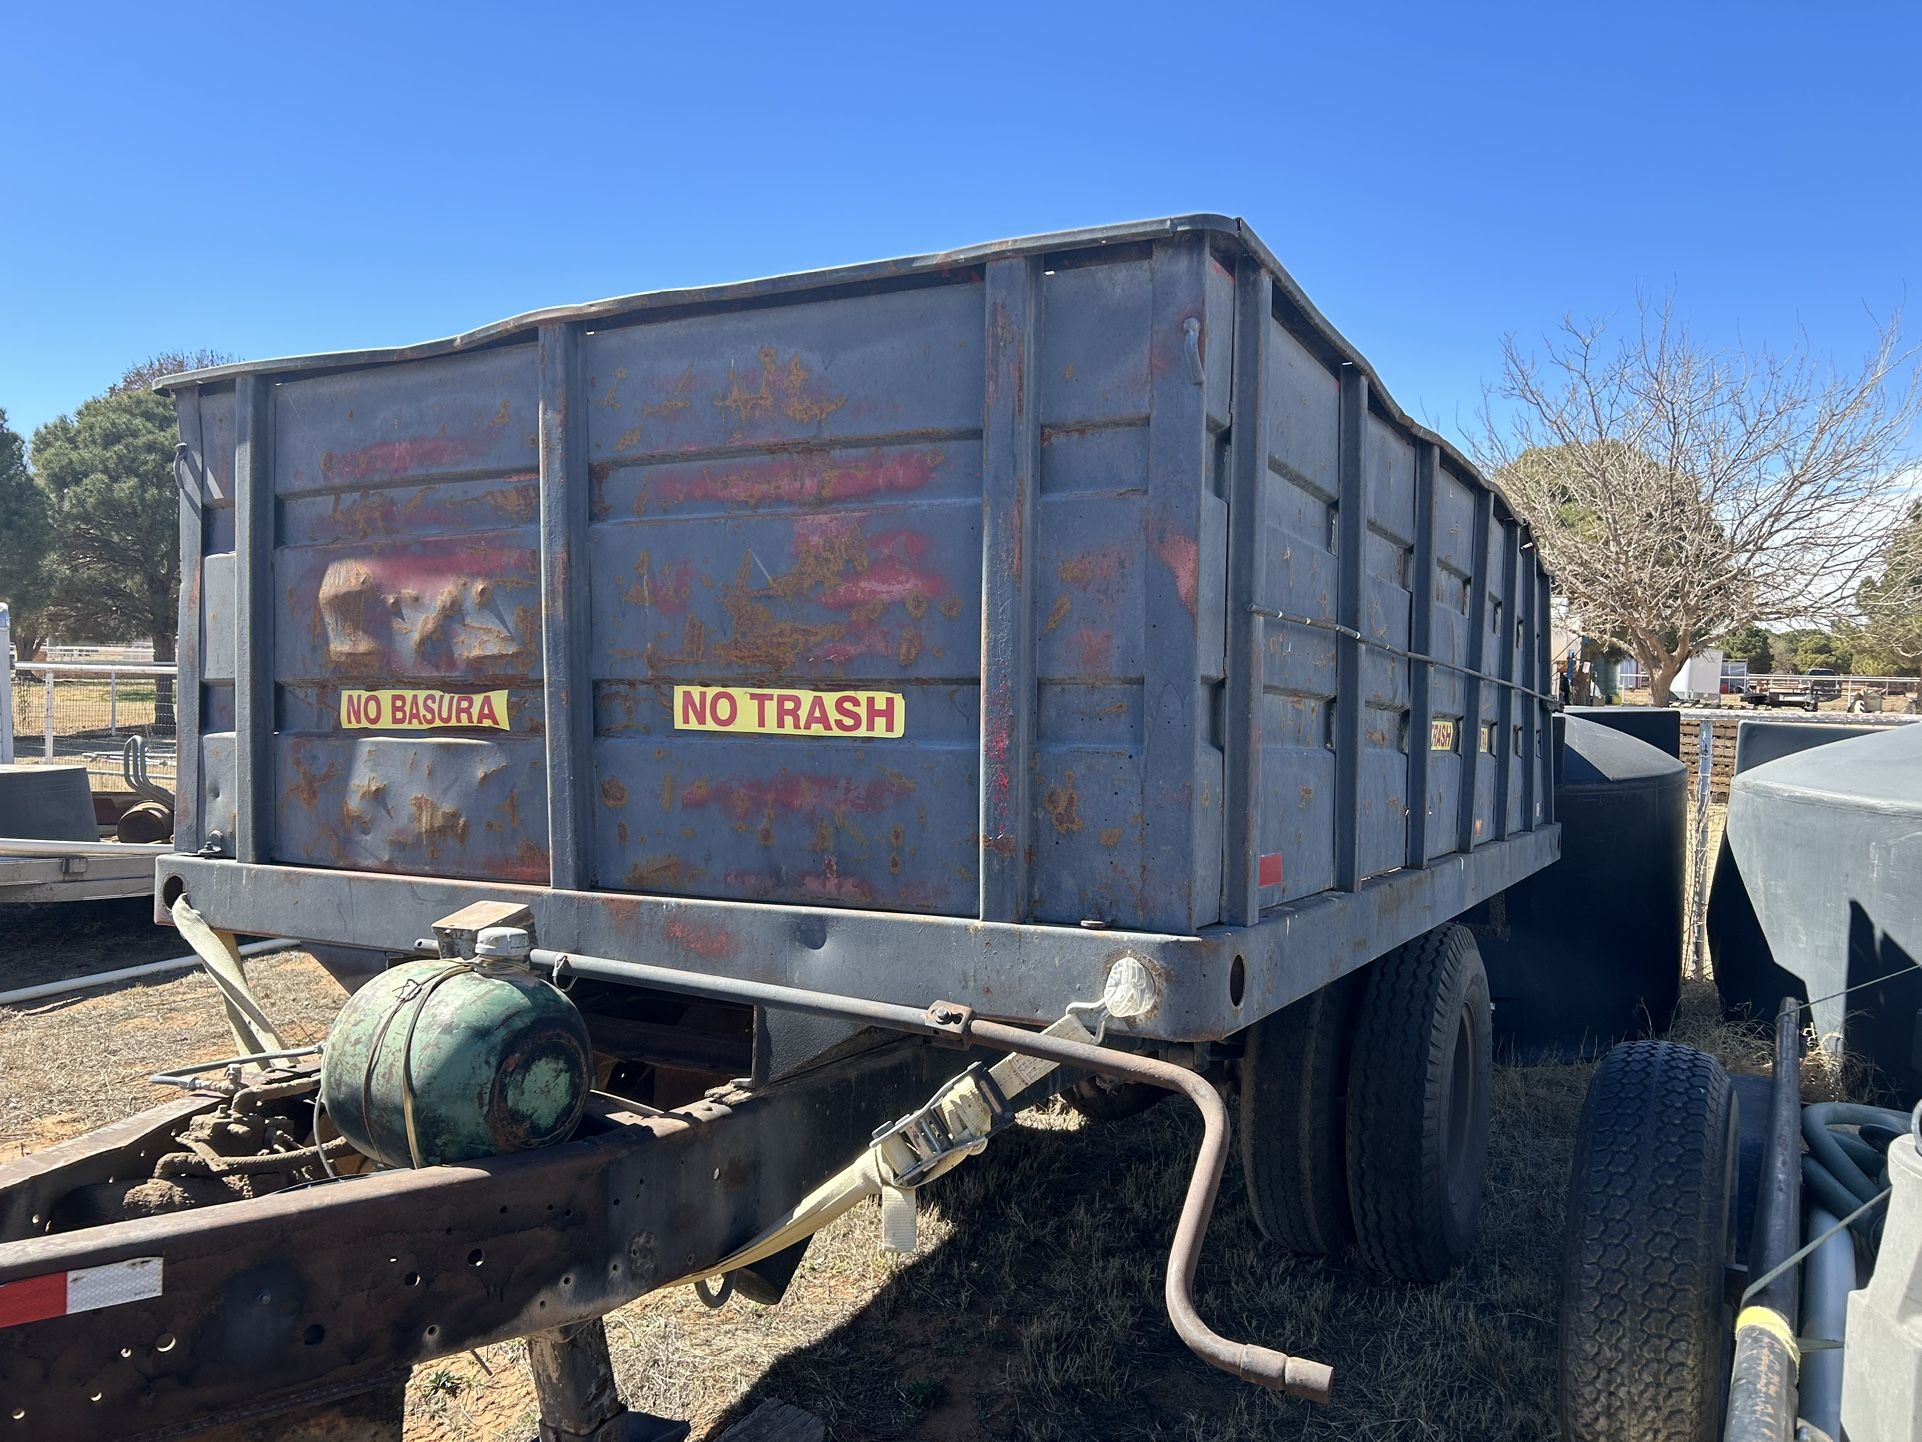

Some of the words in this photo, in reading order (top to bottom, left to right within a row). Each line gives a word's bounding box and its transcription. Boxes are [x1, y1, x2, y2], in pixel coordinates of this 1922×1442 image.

[346, 694, 382, 725] NO
[391, 694, 500, 726] BASURA
[682, 690, 738, 727] NO
[749, 693, 895, 733] TRASH
